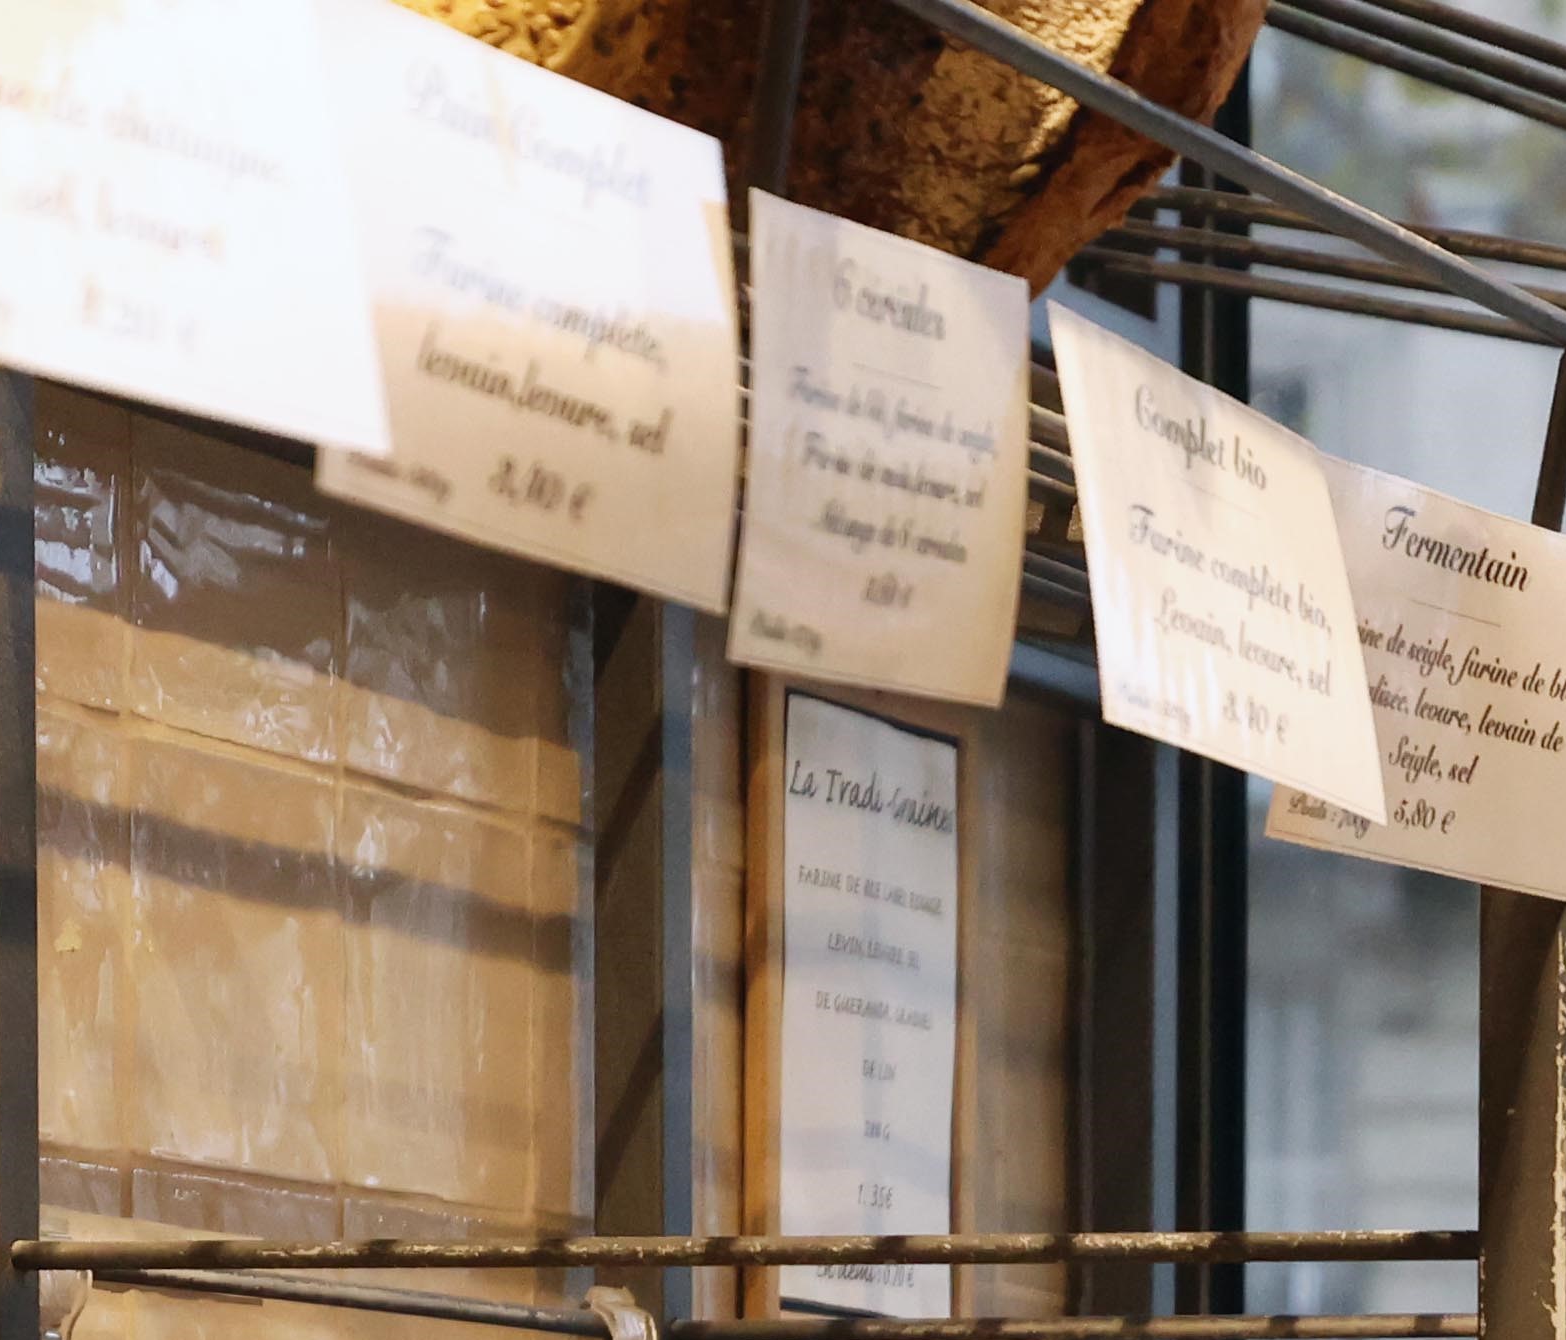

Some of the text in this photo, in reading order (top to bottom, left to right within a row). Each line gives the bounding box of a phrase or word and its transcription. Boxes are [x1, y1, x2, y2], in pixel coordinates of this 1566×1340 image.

[1135, 383, 1268, 492] Complet bio
[1129, 502, 1207, 574] Farine
[1381, 505, 1531, 593] Fermentain
[1356, 618, 1384, 650] ine
[1386, 623, 1407, 656] de
[1407, 637, 1455, 678] seigle,
[1447, 644, 1518, 688] farine
[1521, 662, 1545, 695] de
[1414, 686, 1472, 736] levure,
[1478, 704, 1536, 746] levain
[1540, 719, 1564, 753] de
[789, 760, 817, 798] La
[1388, 735, 1480, 786] Seigle, sel
[1394, 798, 1457, 835] 5,80 €
[797, 864, 842, 892] FARINE
[815, 990, 831, 1010] DE
